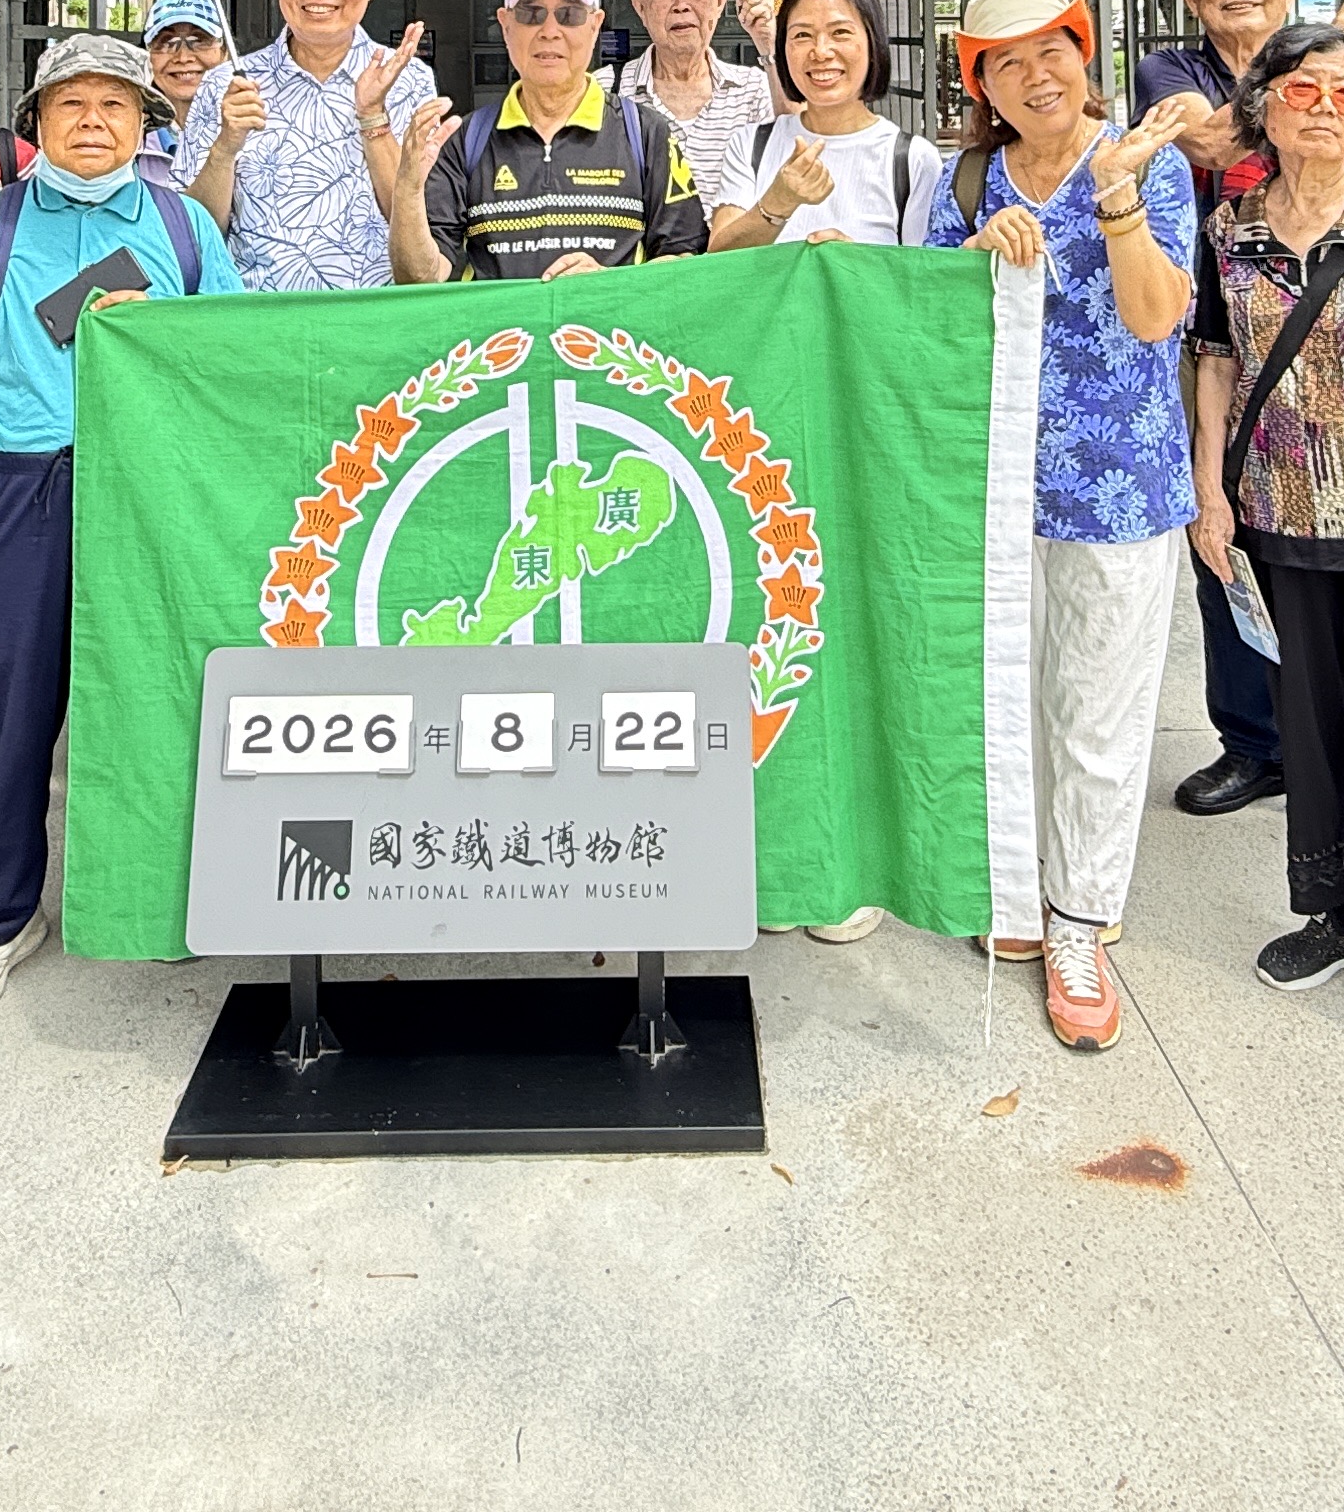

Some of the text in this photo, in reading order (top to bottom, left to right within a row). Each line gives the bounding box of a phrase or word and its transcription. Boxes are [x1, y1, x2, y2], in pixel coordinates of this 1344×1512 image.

[512, 241, 524, 253] LE
[525, 238, 561, 252] PLAISIR
[562, 237, 581, 249] DU
[583, 237, 617, 250] SPORT
[242, 711, 728, 754] 2026 年 8 月 22 日
[369, 819, 669, 870] 國家鐵道博物館
[368, 883, 669, 900] NATIONAL RAILWAY MUSEUM
